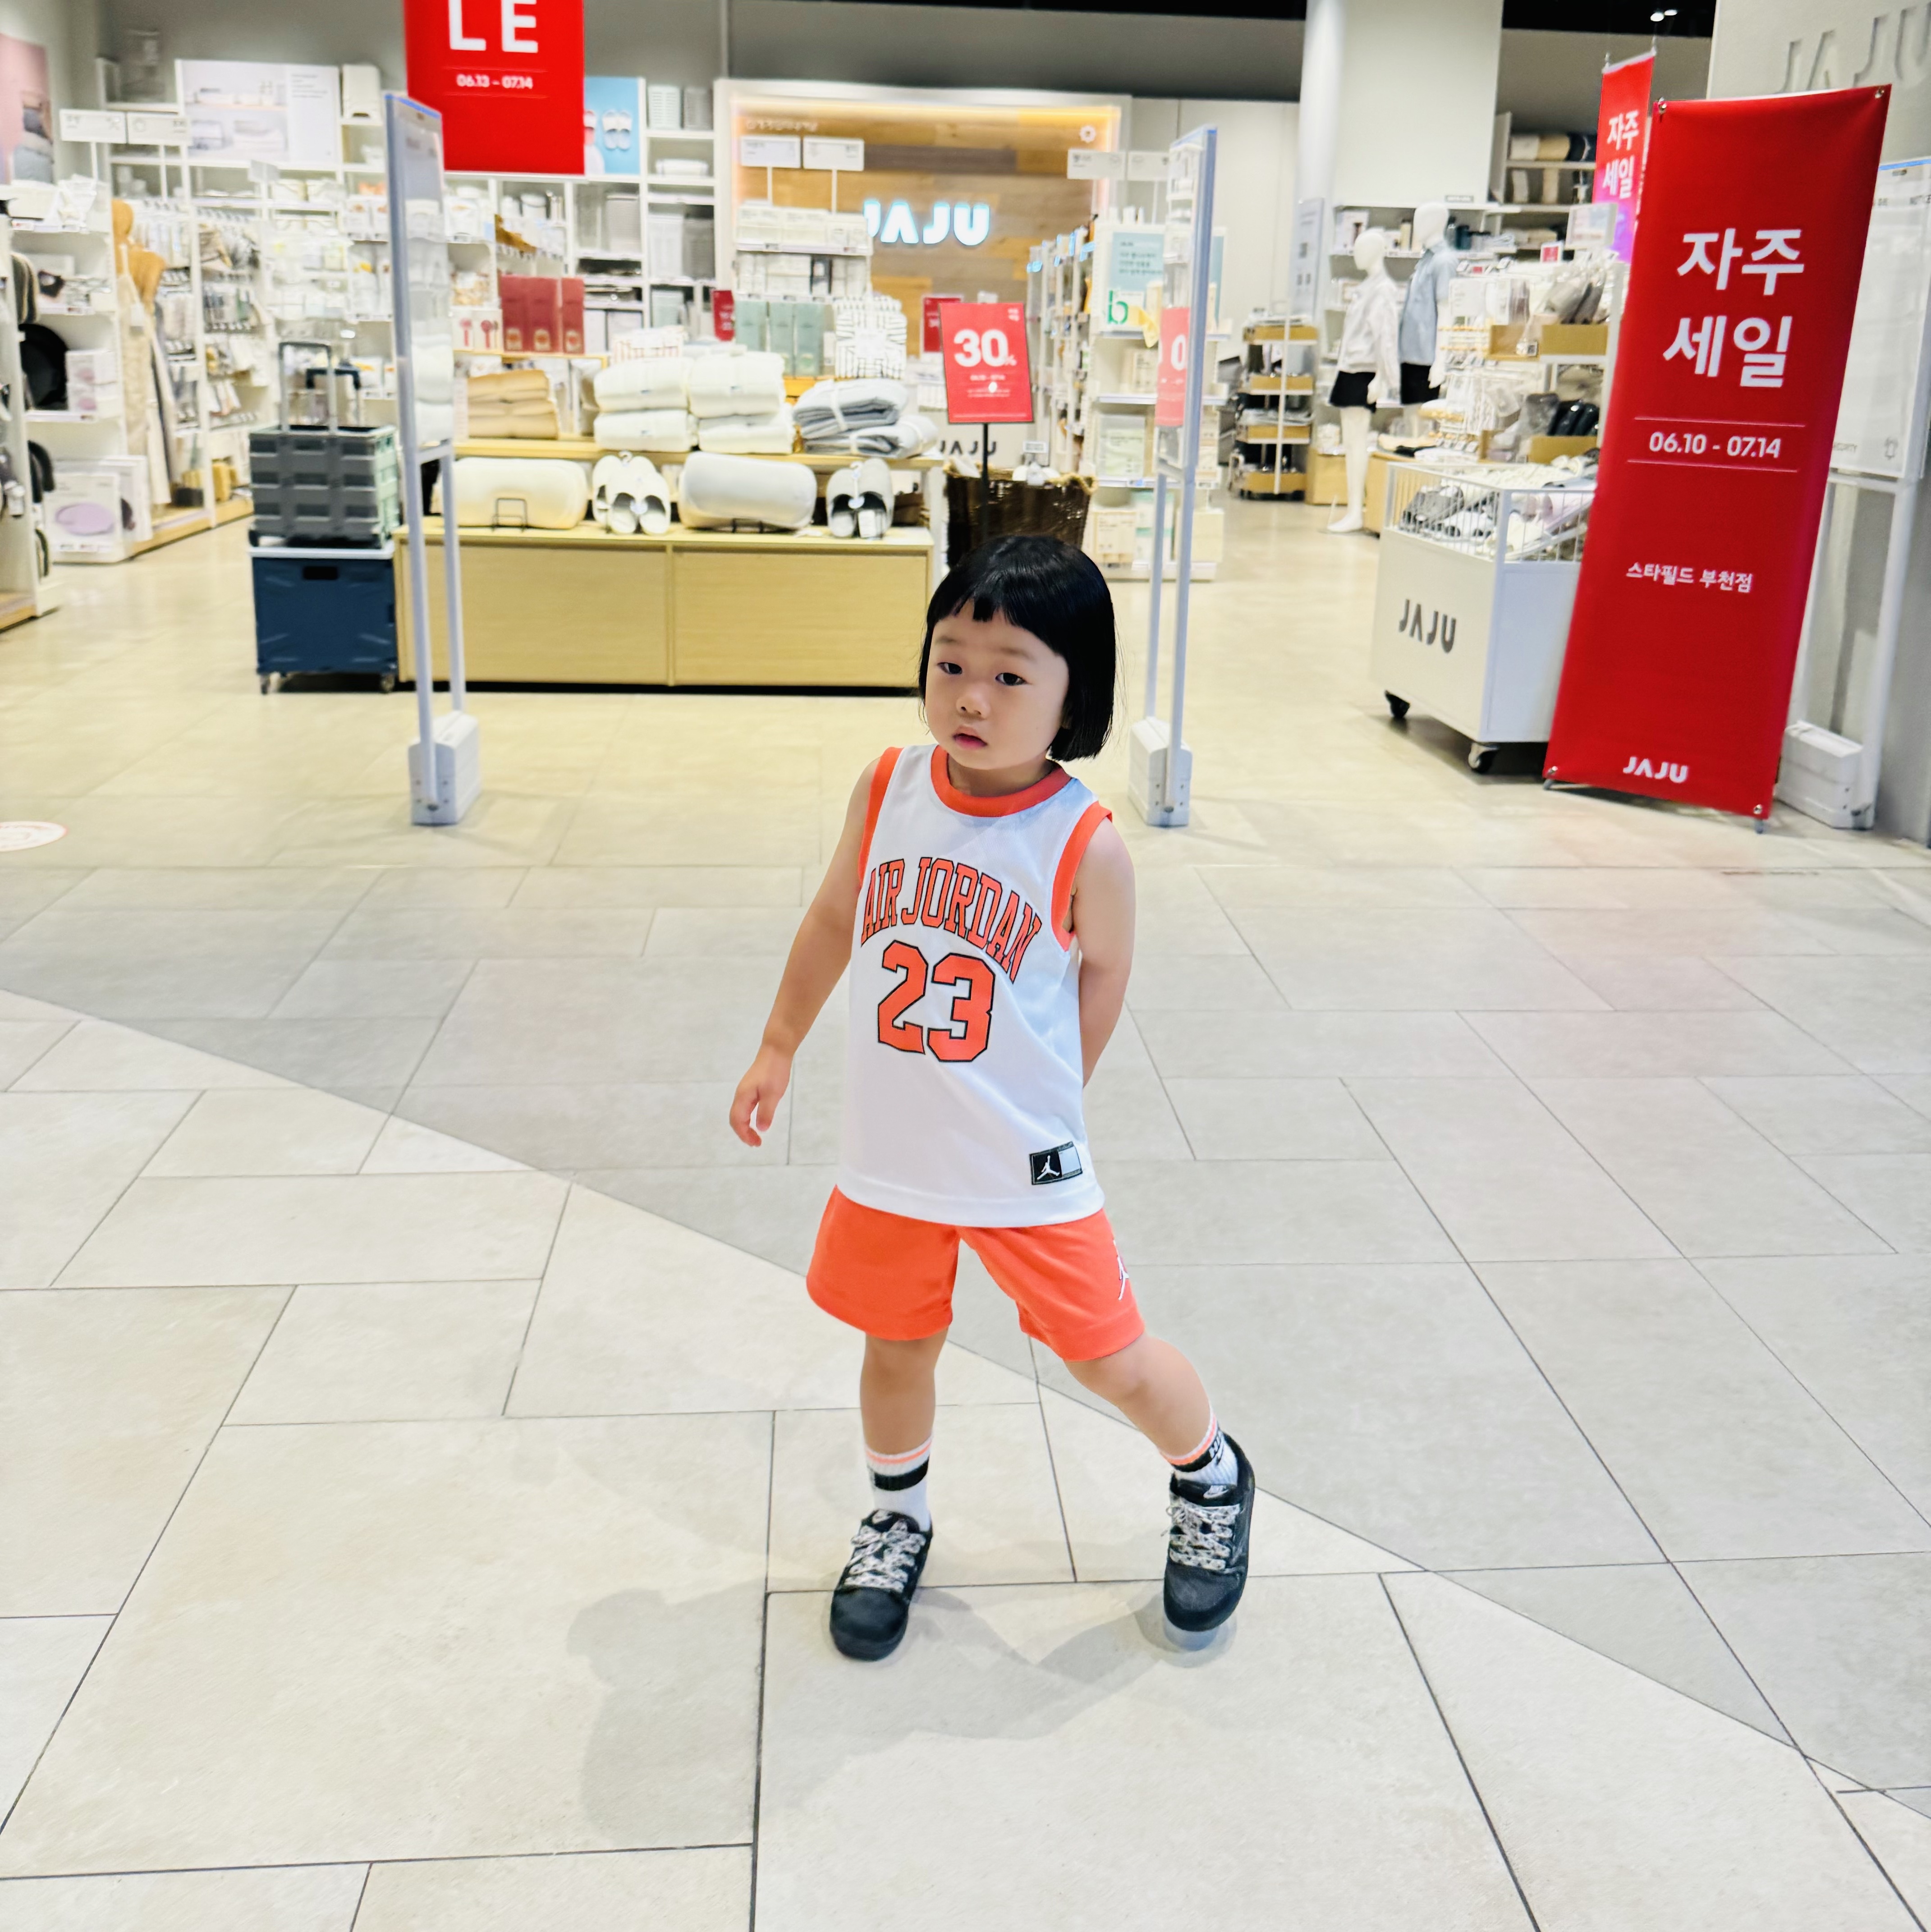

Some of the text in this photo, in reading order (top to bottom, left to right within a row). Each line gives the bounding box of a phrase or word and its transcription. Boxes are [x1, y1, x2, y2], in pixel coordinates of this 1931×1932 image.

[448, 0, 538, 53] LE
[1607, 110, 1639, 151] 자주
[1602, 155, 1635, 199] 세일
[863, 200, 990, 246] JAJU
[1677, 228, 1804, 295] 자주
[1663, 316, 1793, 388] 세일
[1649, 431, 1707, 455] 06.10
[1727, 436, 1782, 459] 07.14
[1626, 562, 1753, 593] 스타필드 부천점
[1399, 599, 1456, 653] JAJU
[1623, 756, 1688, 784] JAJU
[861, 857, 1042, 984] AIR JORDAN
[878, 940, 995, 1063] 23
